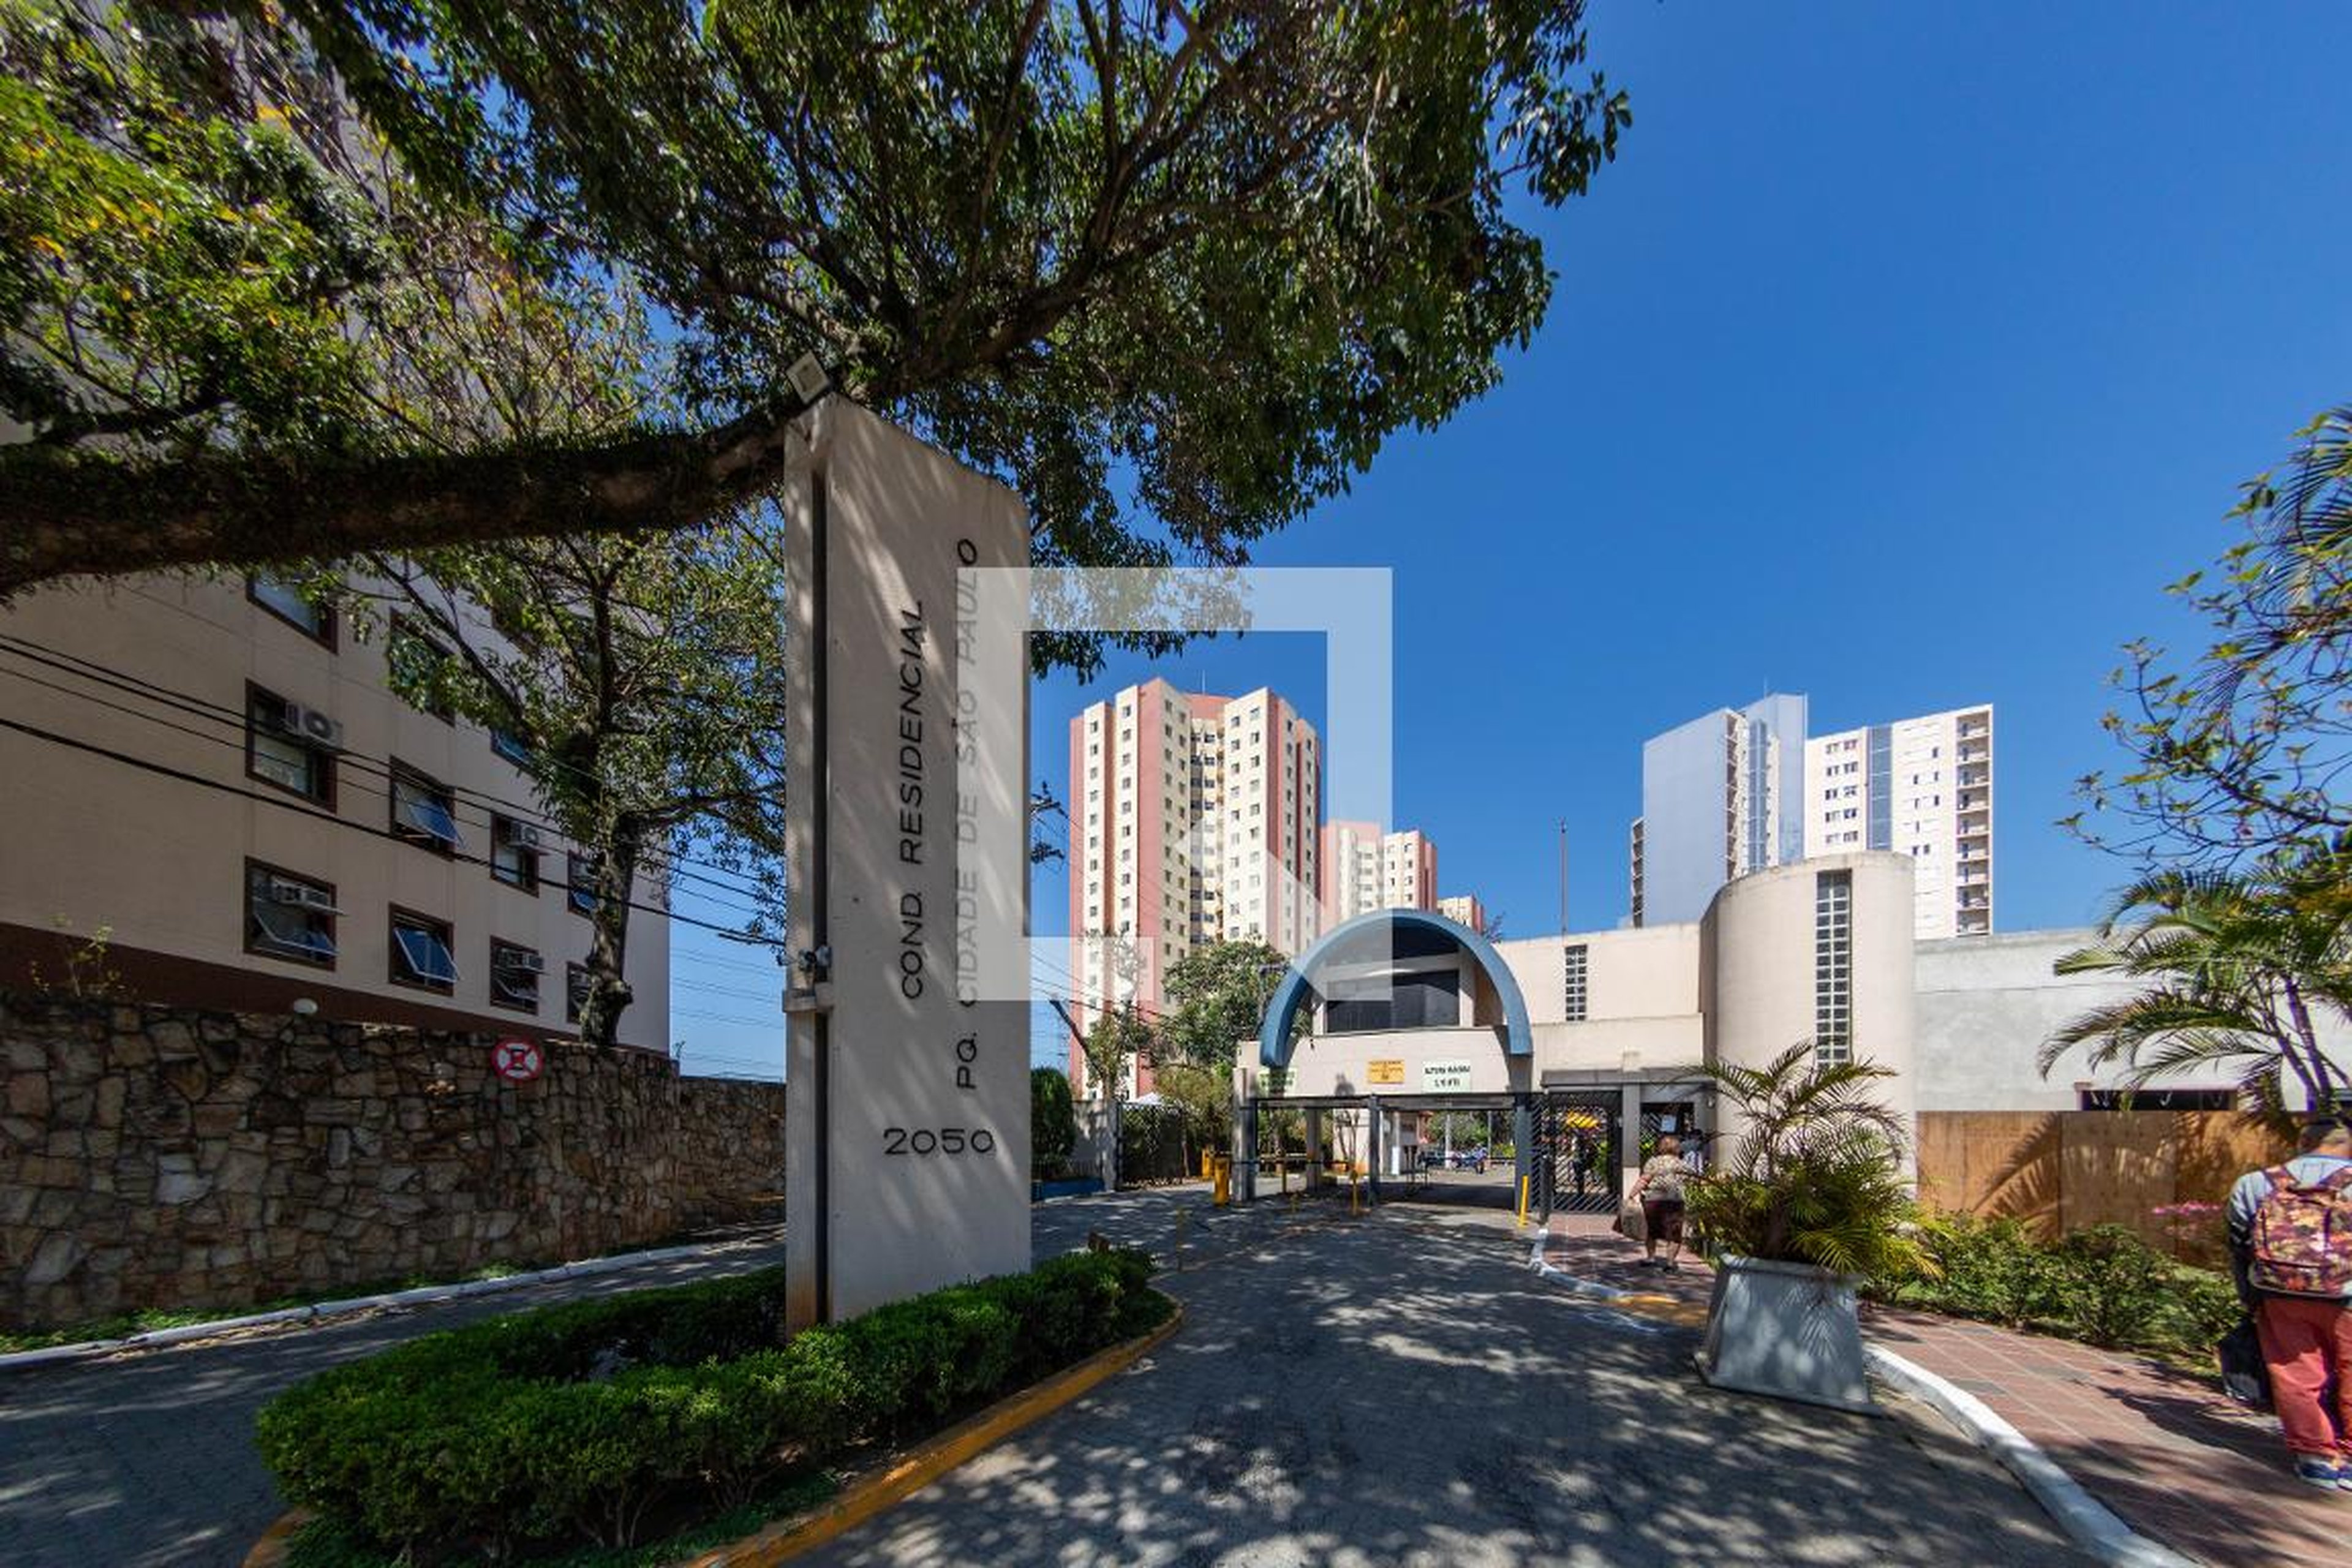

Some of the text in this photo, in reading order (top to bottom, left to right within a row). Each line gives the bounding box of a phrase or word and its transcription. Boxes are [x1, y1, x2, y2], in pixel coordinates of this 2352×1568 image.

[900, 601, 922, 1000] COND. RESIDENCIAL
[952, 538, 978, 1089] PQ. CIDADE DE SÃO PAULO
[884, 1128, 993, 1155] 2050
